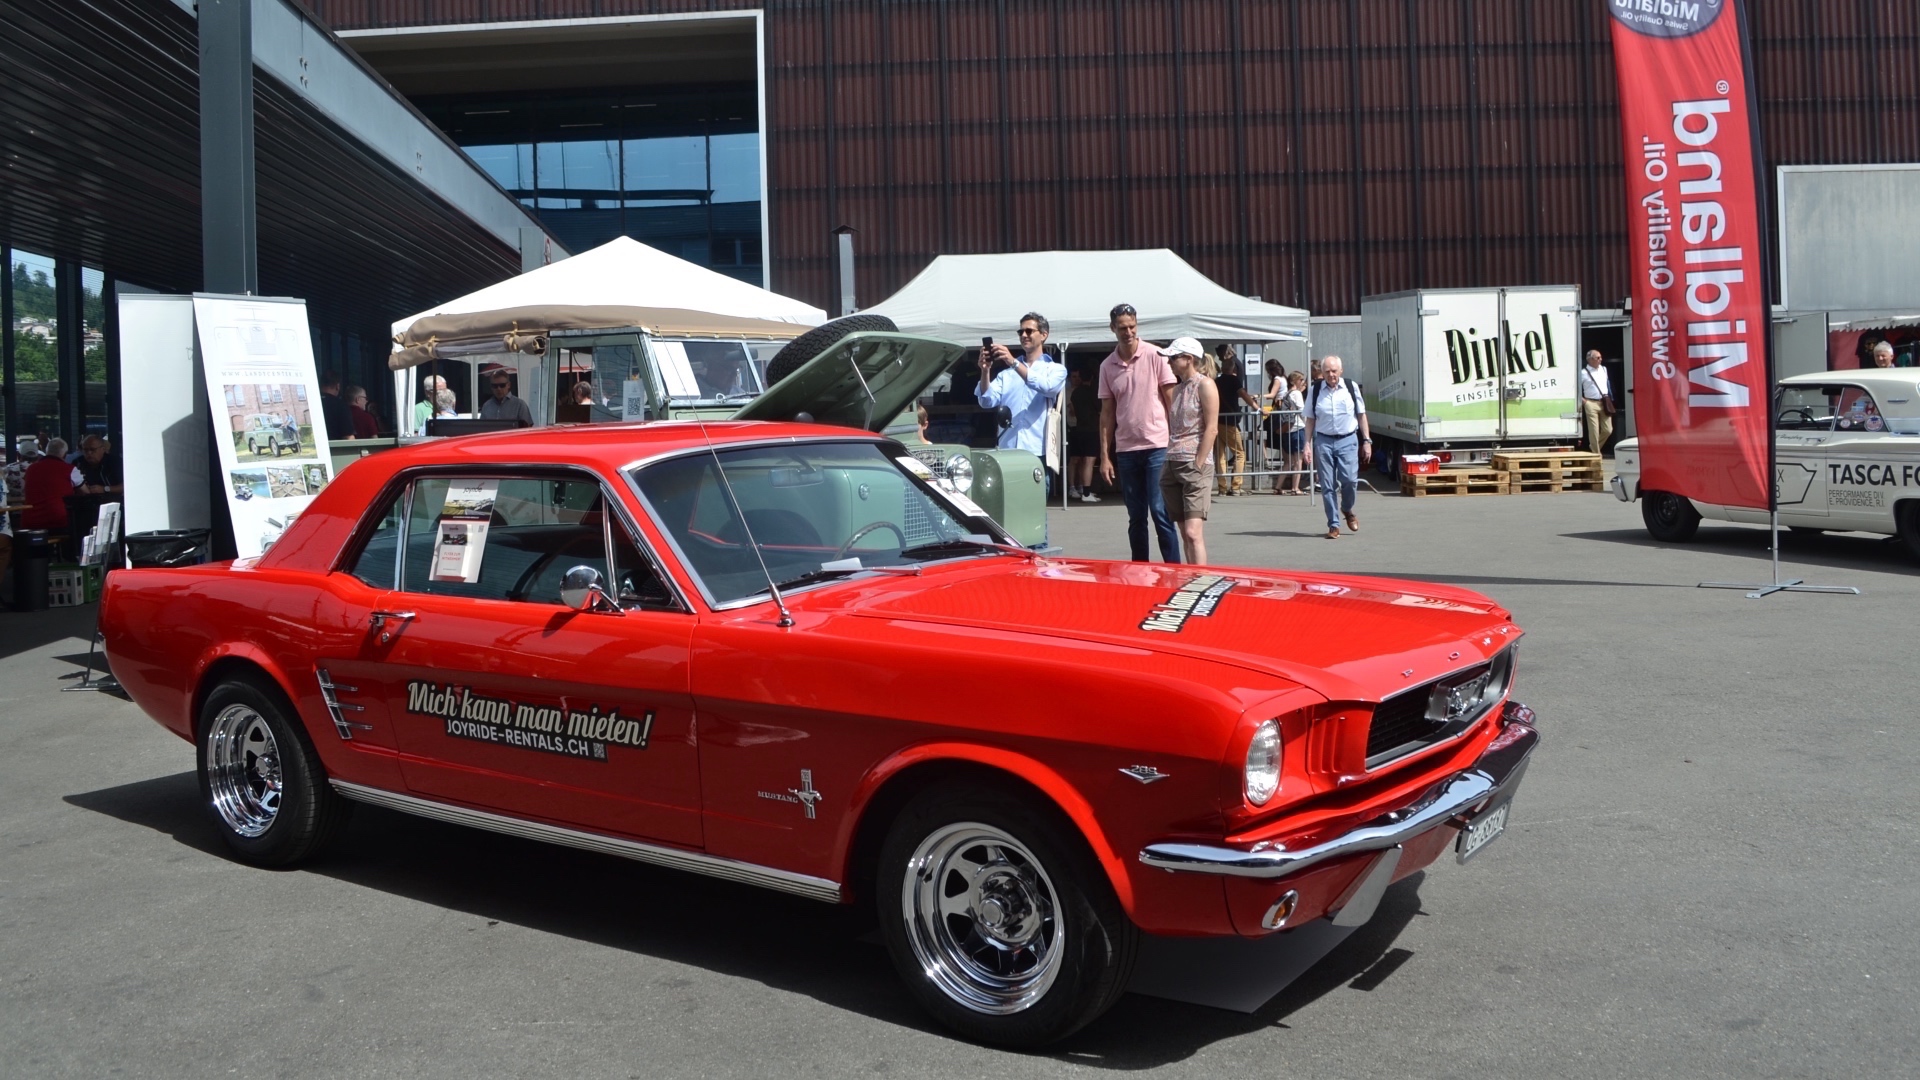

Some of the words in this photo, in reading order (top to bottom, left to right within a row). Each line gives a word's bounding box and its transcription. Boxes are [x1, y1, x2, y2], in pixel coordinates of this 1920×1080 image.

[1443, 313, 1558, 385] Dinkel
[1828, 464, 1896, 486] TASCA
[1829, 490, 1872, 499] PERFORMANCE
[408, 682, 458, 717] Mich
[461, 689, 512, 725] kann
[515, 704, 564, 733] man
[567, 707, 652, 746] mieten!
[448, 719, 589, 756] JOYRIDE-RENTALS.CH
[1131, 765, 1158, 775] 289
[757, 791, 798, 803] MUSTANG
